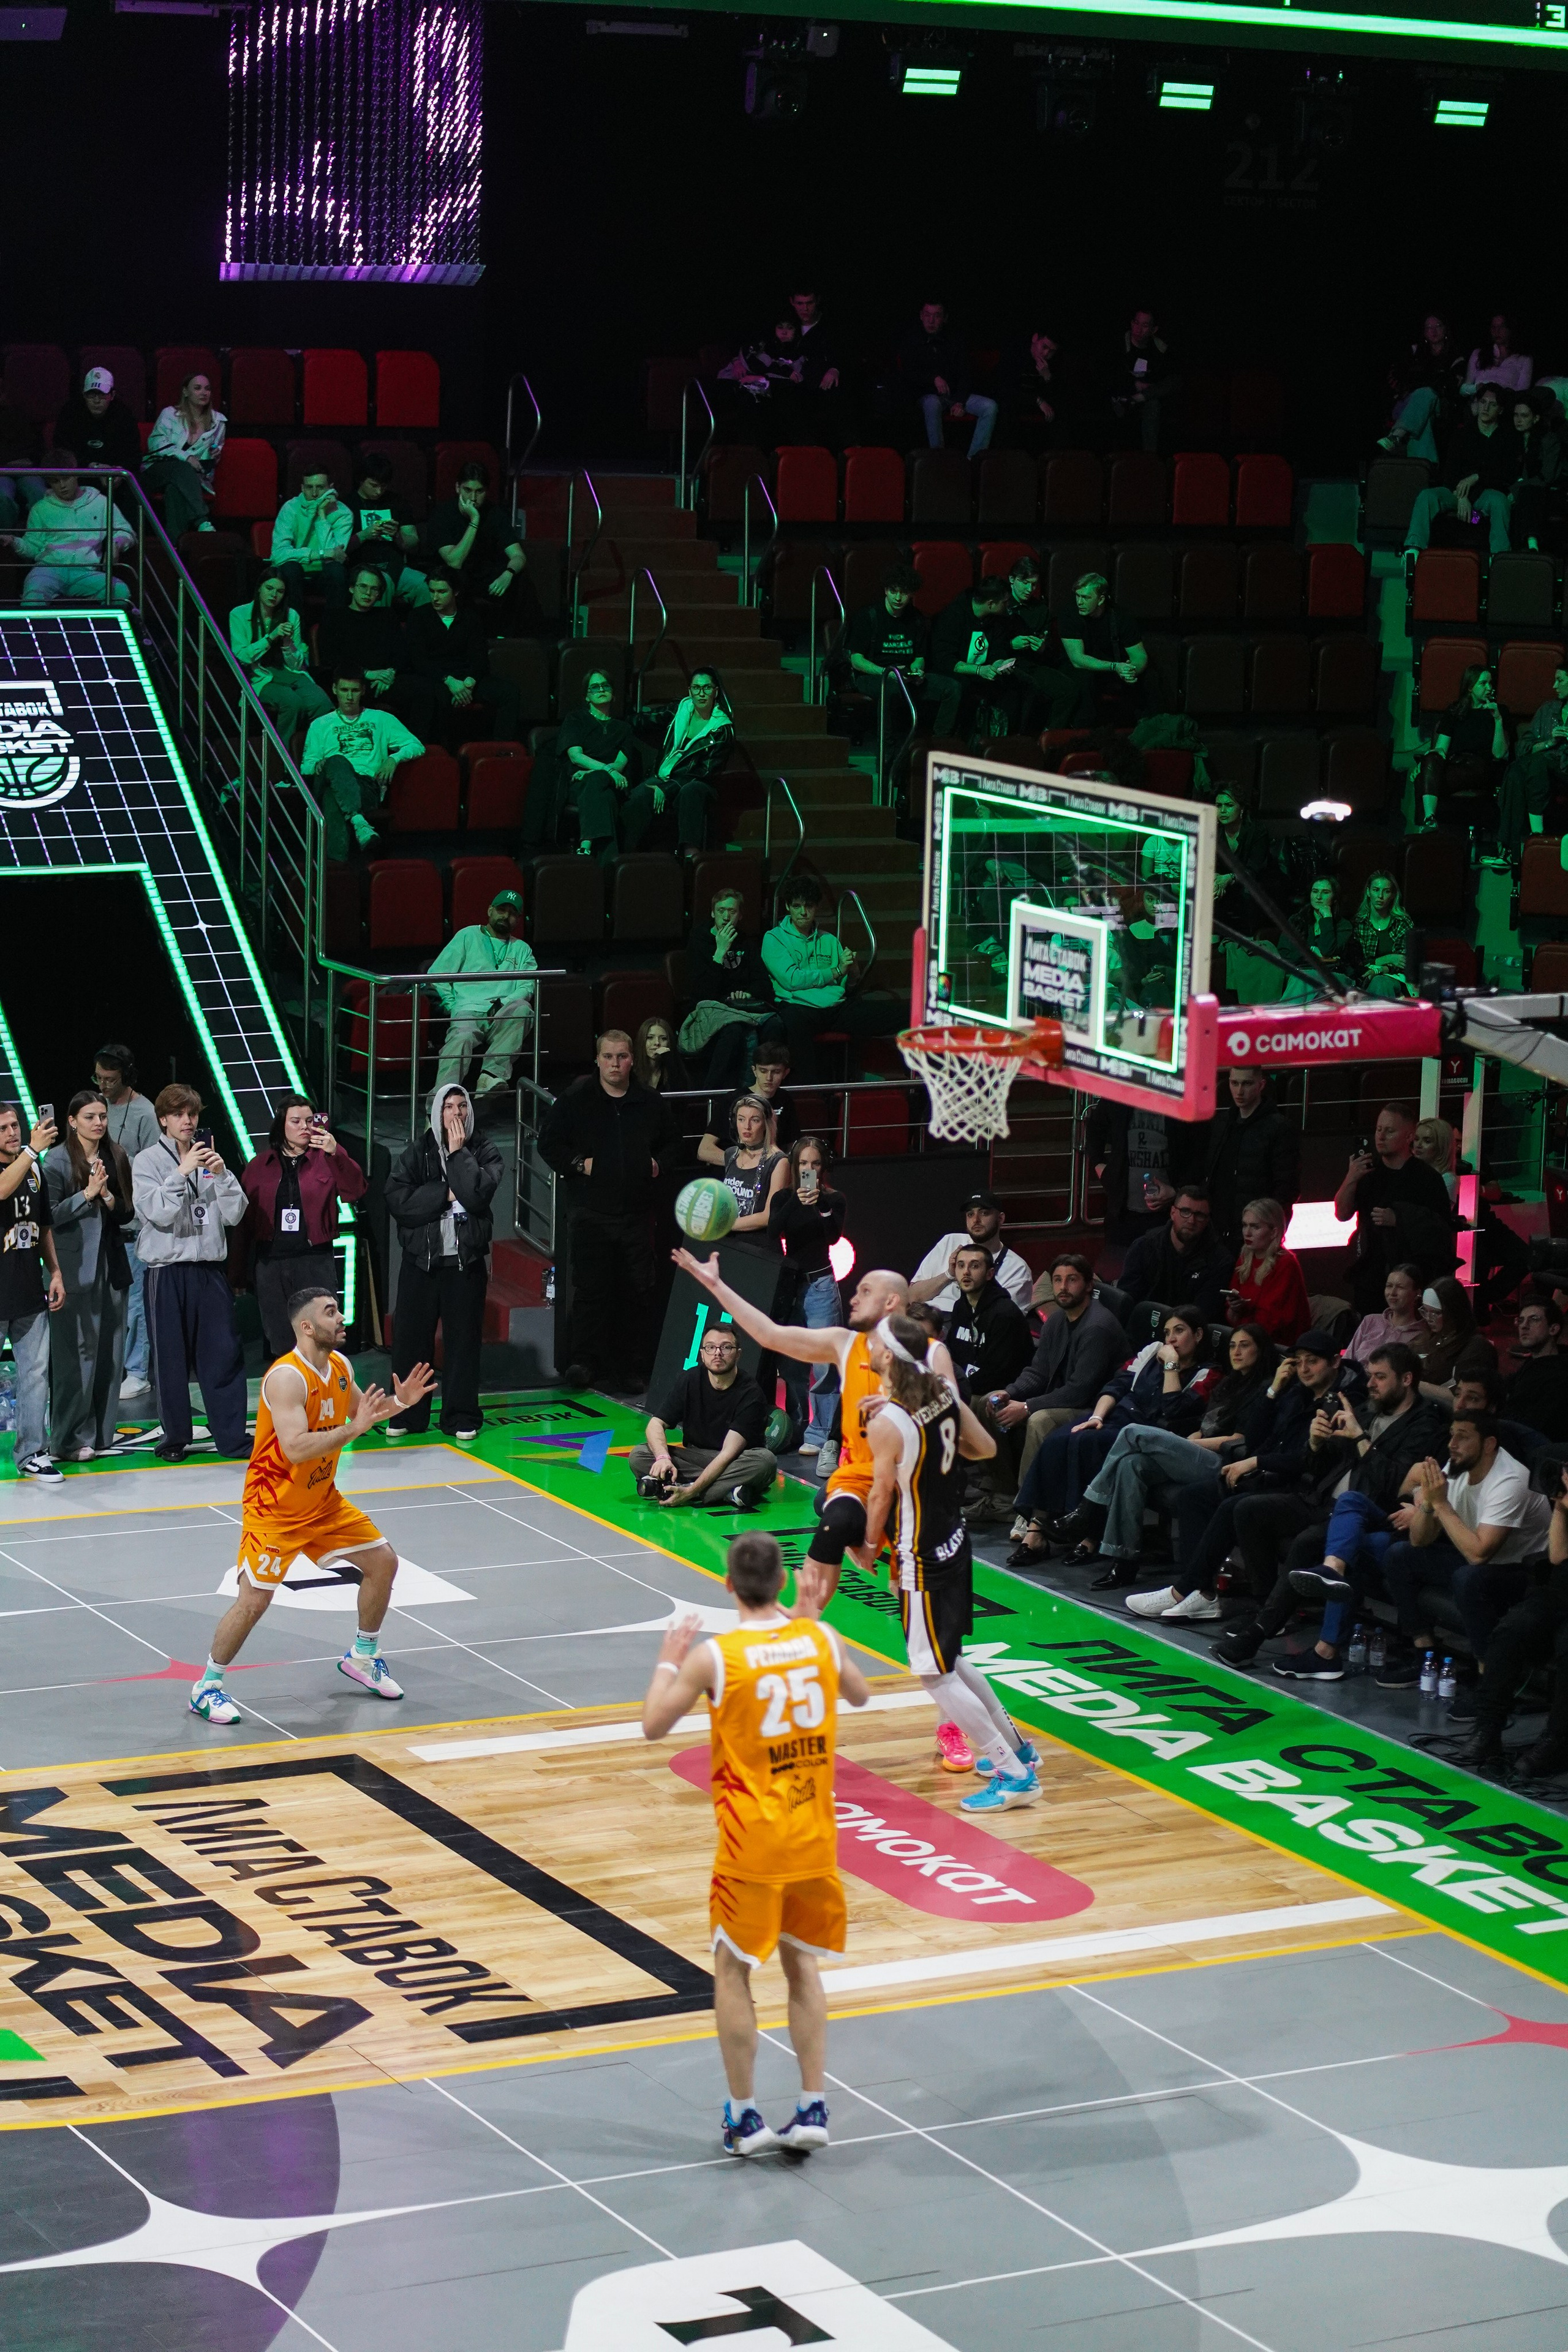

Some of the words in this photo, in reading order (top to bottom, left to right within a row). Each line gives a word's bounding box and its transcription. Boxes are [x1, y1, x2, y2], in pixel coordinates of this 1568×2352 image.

[1023, 961, 1085, 993] MEDIA
[1022, 982, 1085, 1009] BASKET
[724, 1177, 744, 1187] nder
[728, 1186, 754, 1198] OUND
[482, 1411, 579, 1428] ТАВОК
[939, 1417, 956, 1475] 8
[257, 1554, 281, 1577] 24
[755, 1665, 826, 1737] 25
[962, 1642, 1213, 1762] MEDIA
[1026, 1639, 1275, 1736] ЛИГА
[769, 1736, 827, 1764] MASTER
[831, 1791, 1037, 1905] амокат
[132, 1798, 325, 1882] ЛИГА
[254, 1875, 533, 2016] СТАВОК
